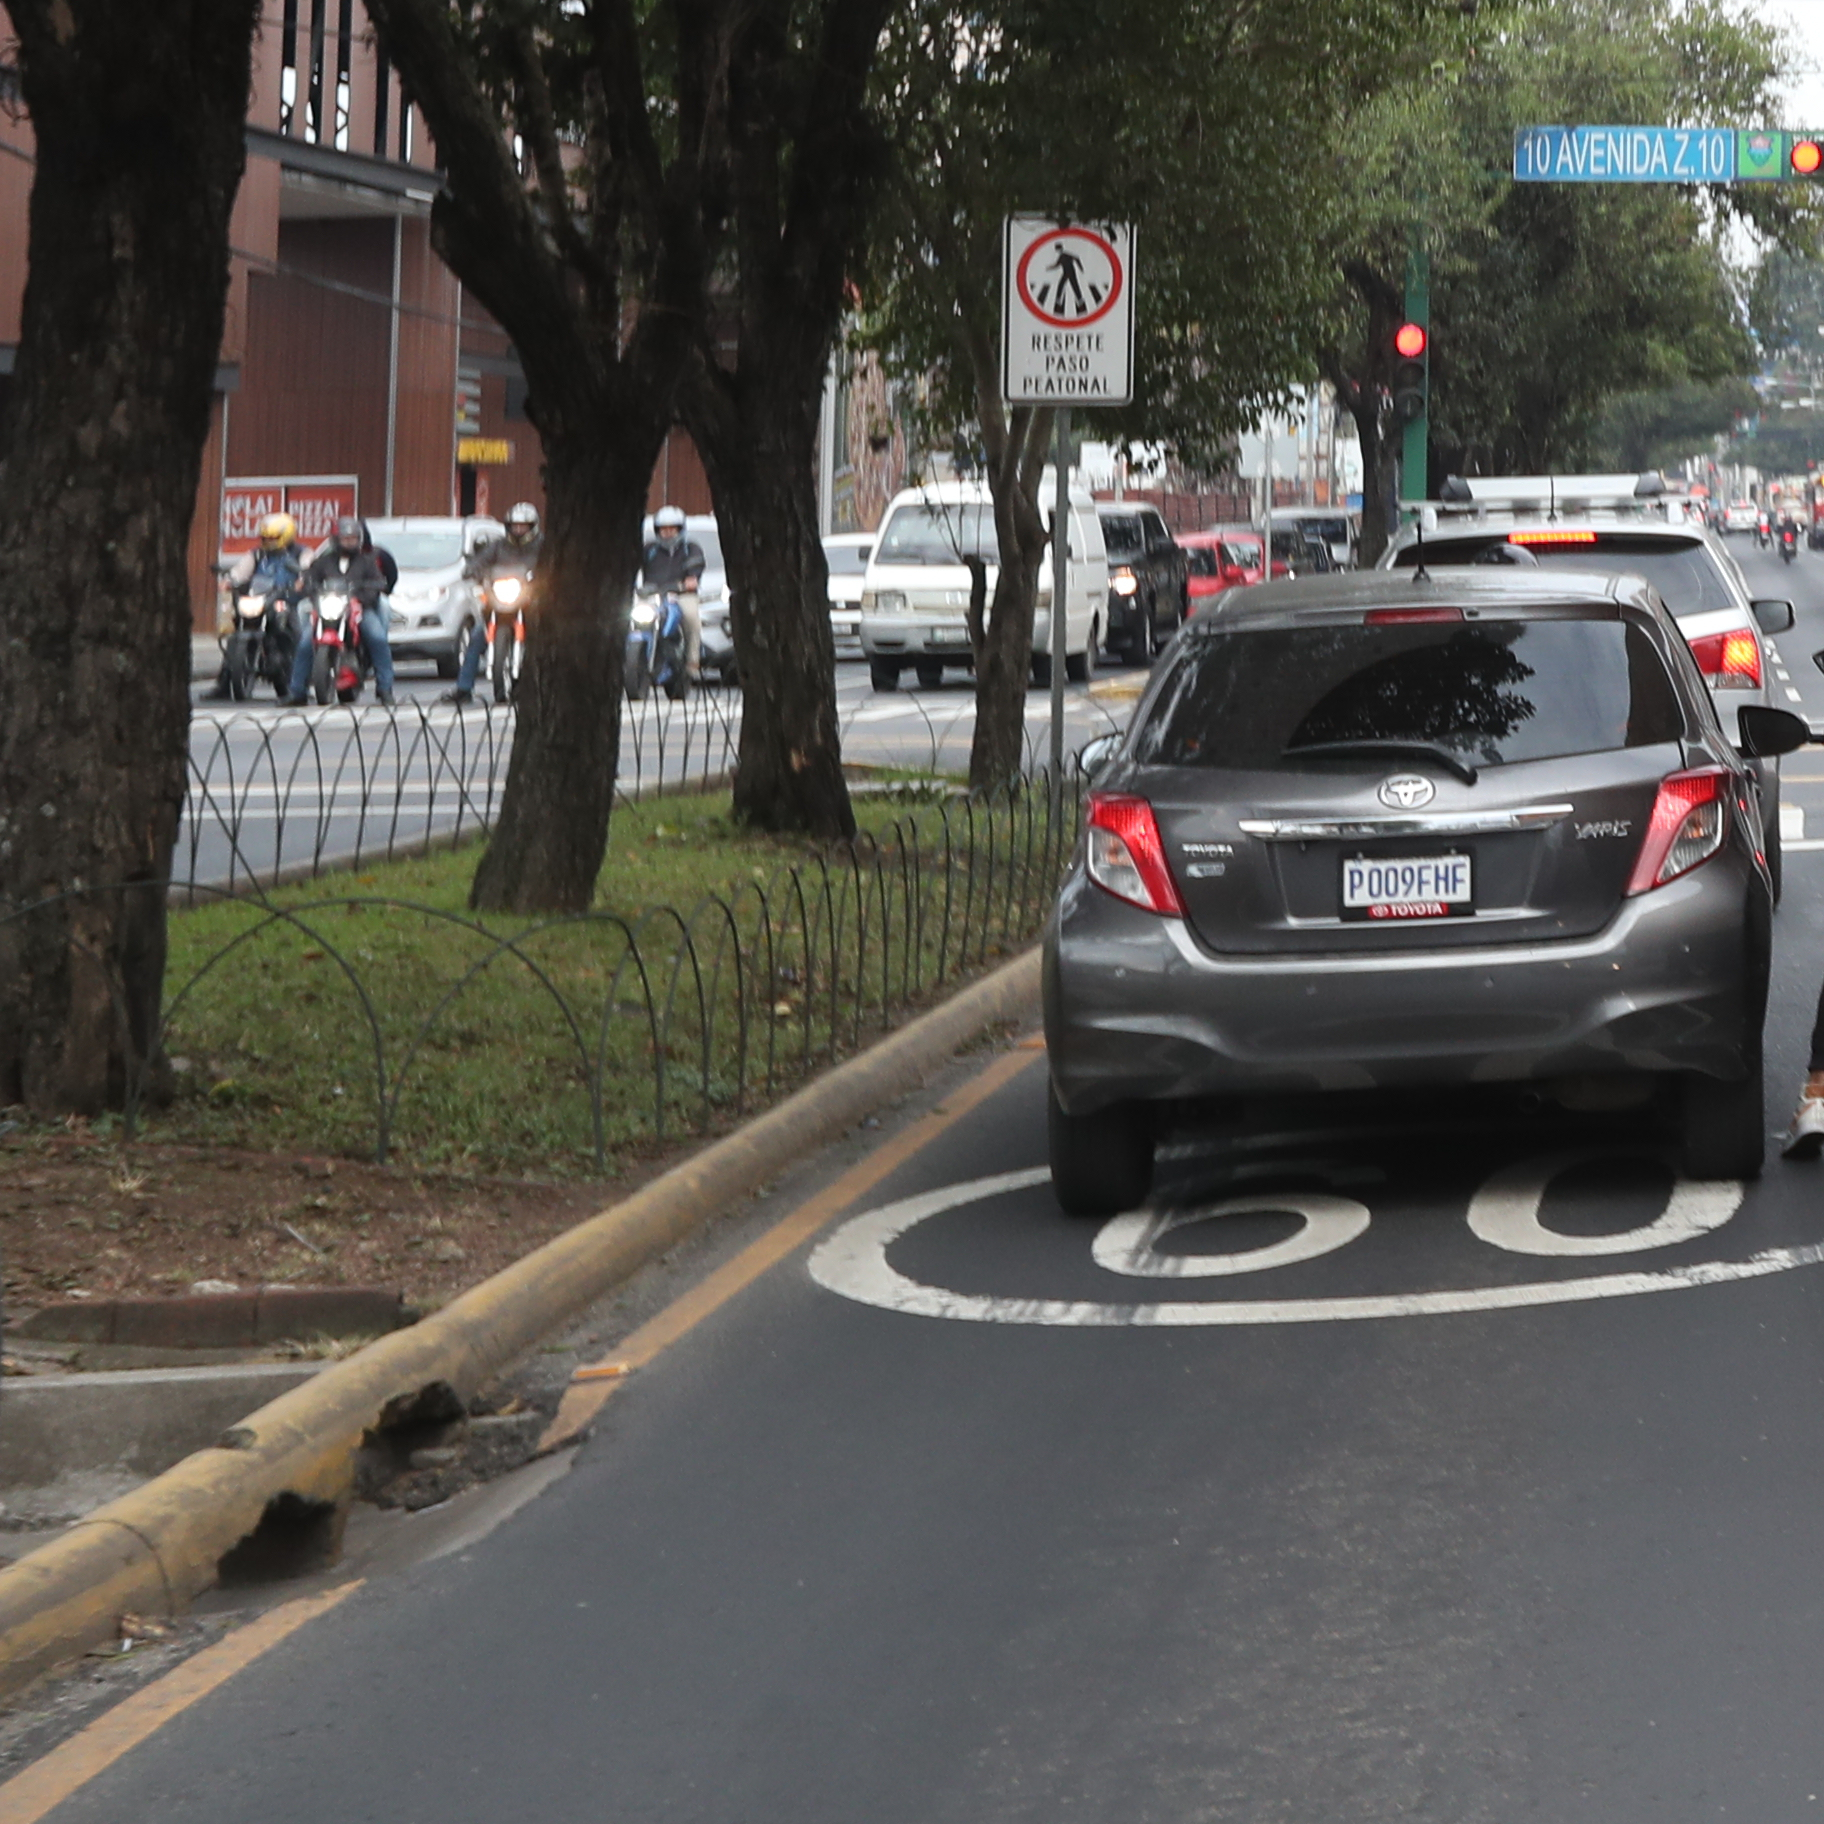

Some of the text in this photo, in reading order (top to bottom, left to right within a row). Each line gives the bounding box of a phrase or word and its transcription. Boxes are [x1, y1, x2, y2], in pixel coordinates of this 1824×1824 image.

[1523, 132, 1725, 175] 10 AVENIDA Z. 10
[1031, 333, 1104, 352] RESPETE
[1045, 355, 1089, 374] PASO
[1023, 376, 1111, 395] PEATONAL
[1391, 902, 1443, 915] TOYOTA
